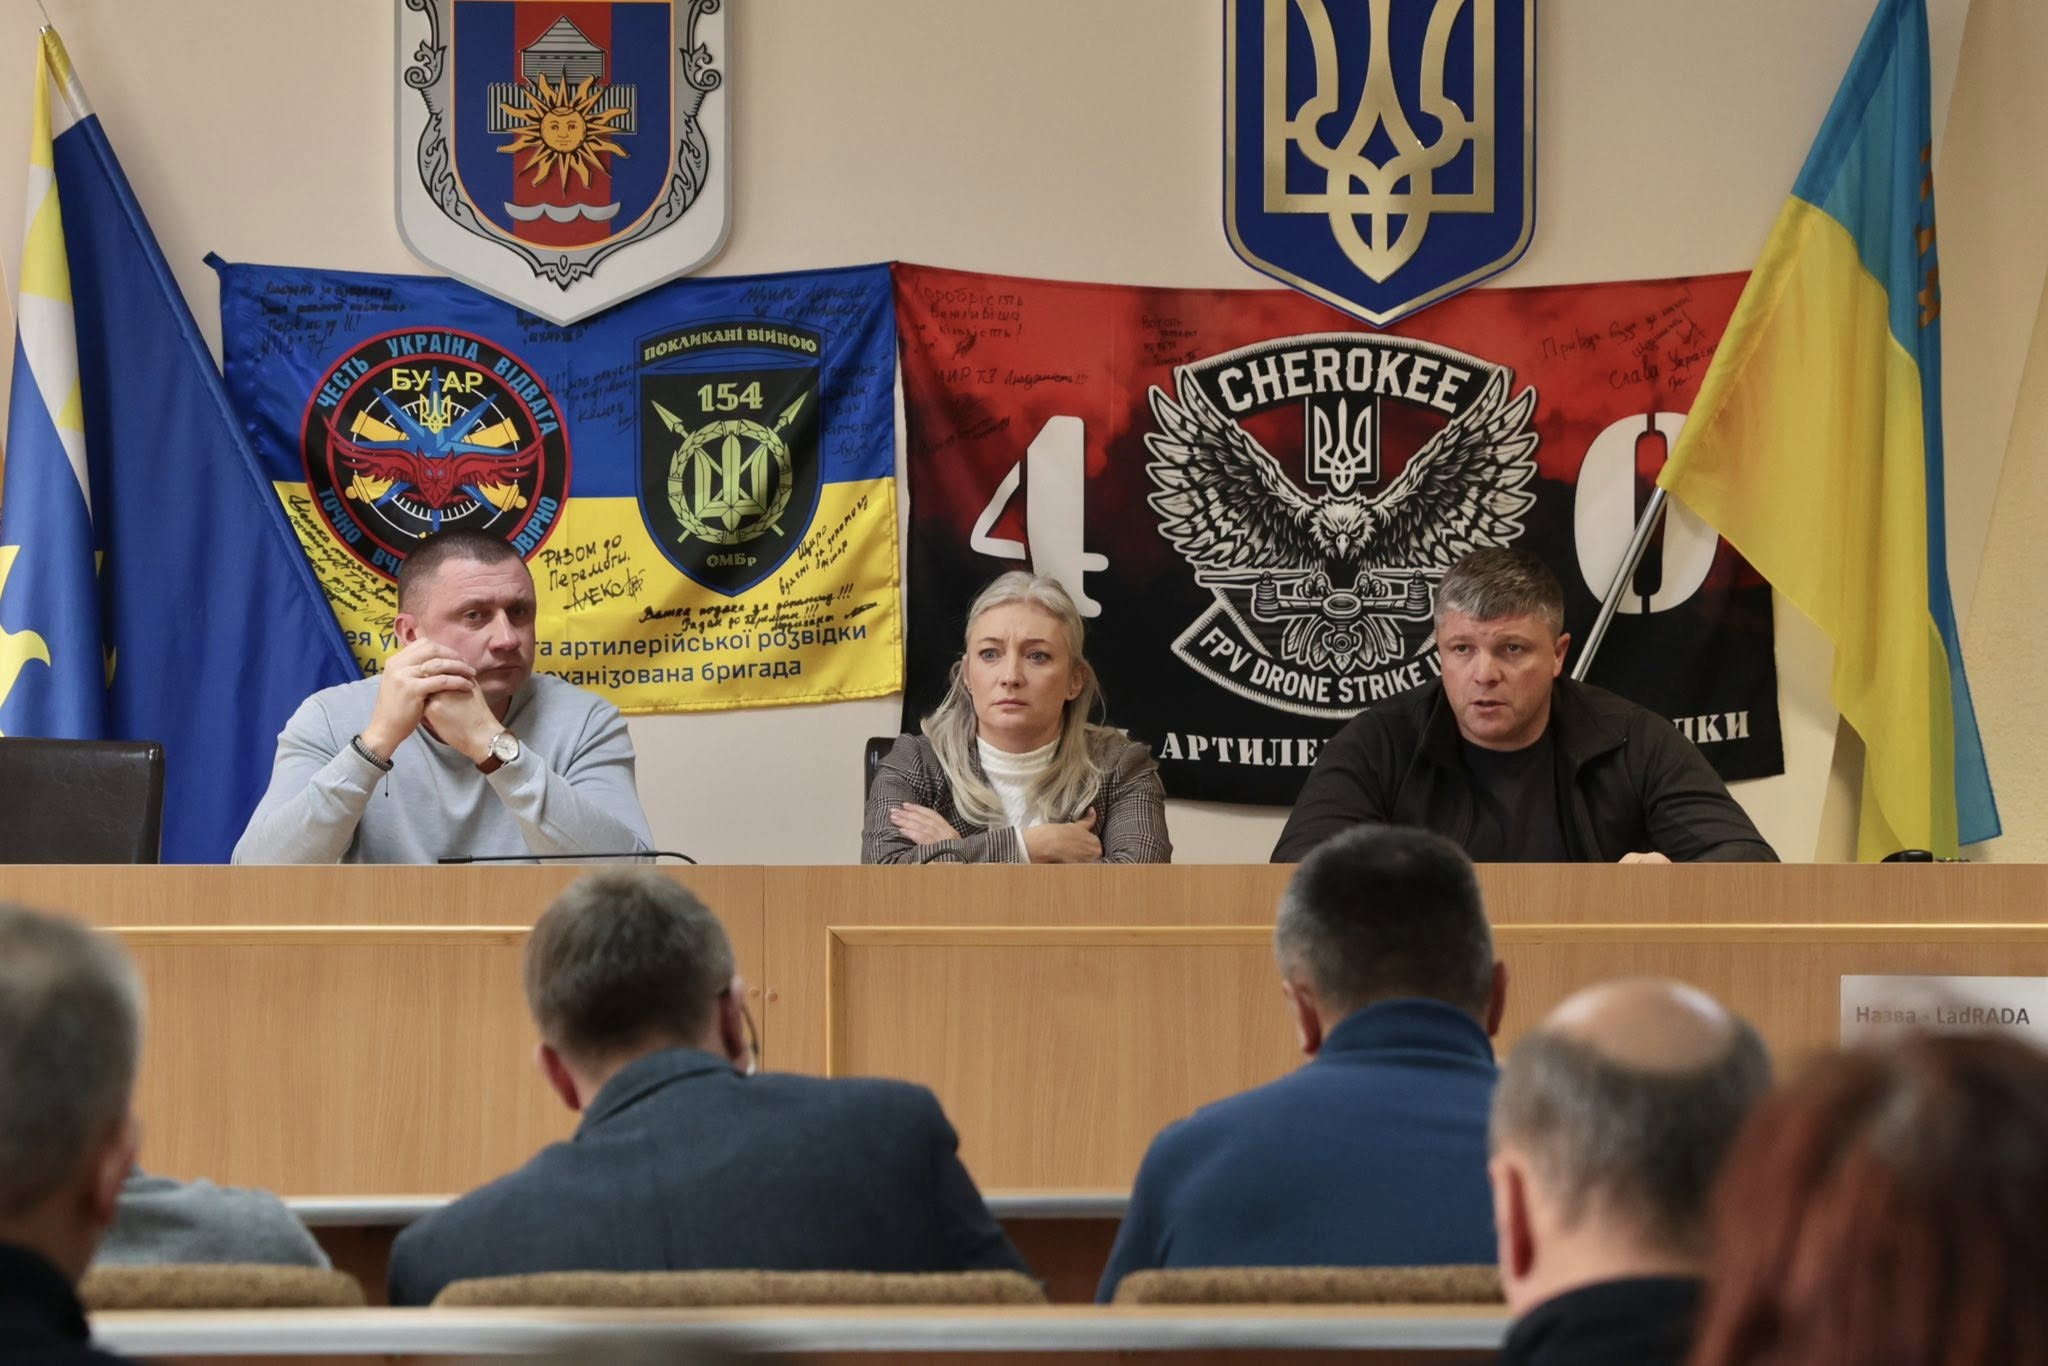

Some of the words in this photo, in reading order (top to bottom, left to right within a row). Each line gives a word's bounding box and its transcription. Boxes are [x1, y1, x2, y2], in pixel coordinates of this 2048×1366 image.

[643, 326, 743, 361] ПОКЛИКАНІ
[747, 328, 817, 353] ВІЙНОЮ
[316, 356, 370, 408] ЧЕСТЬ
[386, 332, 480, 362] УКРАЇНА
[493, 356, 560, 437] ВІДВАГА
[697, 381, 764, 412] 154
[1217, 347, 1472, 413] CHEROKEE
[318, 486, 362, 545] ТОЧНО
[970, 415, 1109, 617] 4
[539, 541, 597, 568] РАЗОМ
[706, 553, 757, 568] ОМБр
[345, 630, 371, 647] ея
[560, 629, 750, 660] артилерійської
[759, 624, 866, 651] розвідки
[536, 665, 694, 690] ханізована
[702, 661, 801, 684] бригада
[1199, 626, 1251, 674] FPV
[1250, 658, 1332, 702] DRONE
[1338, 661, 1426, 703] STRIKE
[1159, 732, 1329, 766] АРТИЛЕ
[1856, 1006, 1917, 1024] Назва
[1937, 1006, 2030, 1025] LadRADA
